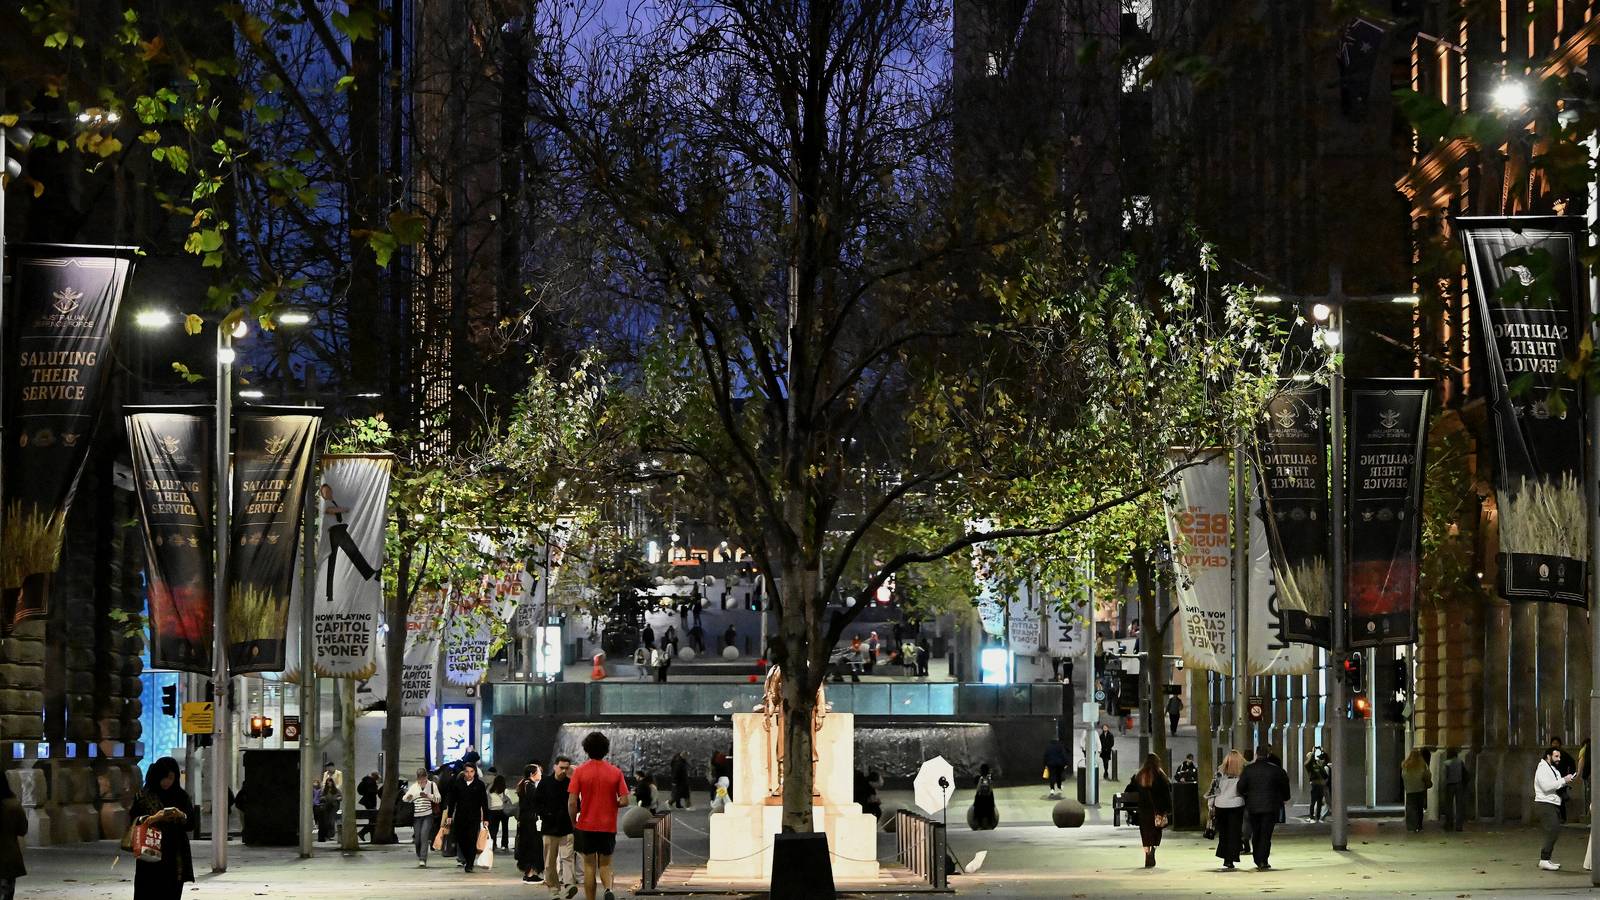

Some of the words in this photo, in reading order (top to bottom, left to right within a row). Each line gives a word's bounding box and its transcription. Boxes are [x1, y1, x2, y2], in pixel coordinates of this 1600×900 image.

[20, 351, 96, 367] SALUTING
[32, 368, 79, 383] THEIR
[22, 385, 85, 401] SERVICE
[316, 622, 370, 633] CAPITOL
[316, 634, 369, 644] THEATRE
[318, 645, 368, 656] SYDNEY
[403, 671, 432, 680] APITOL
[402, 680, 431, 689] HEATRE
[401, 690, 430, 699] YDNEY
